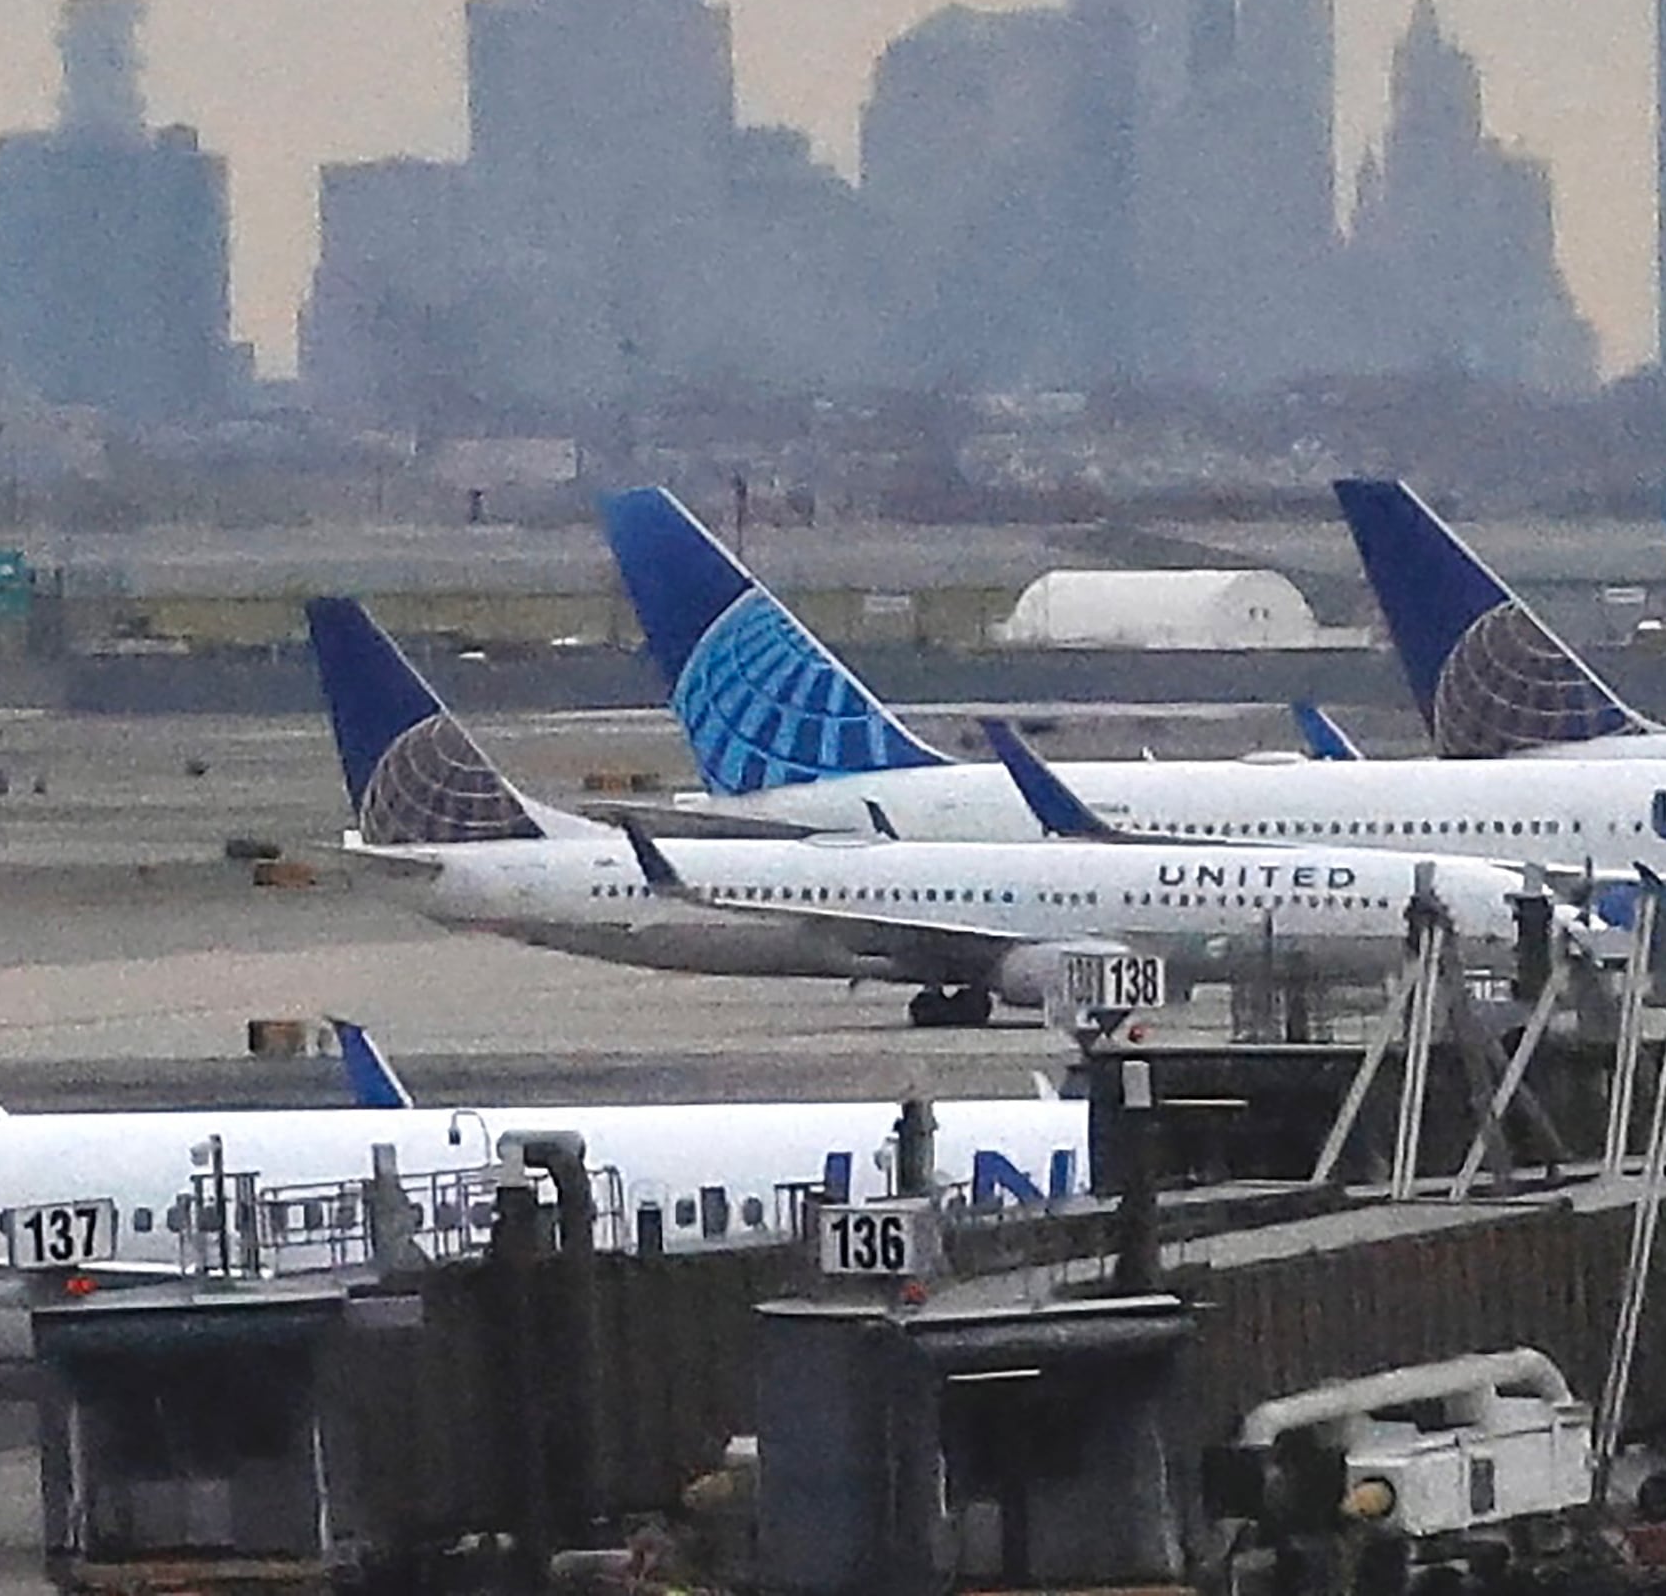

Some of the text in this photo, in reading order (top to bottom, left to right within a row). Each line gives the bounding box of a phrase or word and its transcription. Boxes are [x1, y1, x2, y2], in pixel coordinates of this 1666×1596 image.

[1158, 865, 1356, 889] UNITED
[1110, 958, 1157, 1006] 138
[23, 1207, 97, 1261] 137
[832, 1215, 905, 1270] 136
